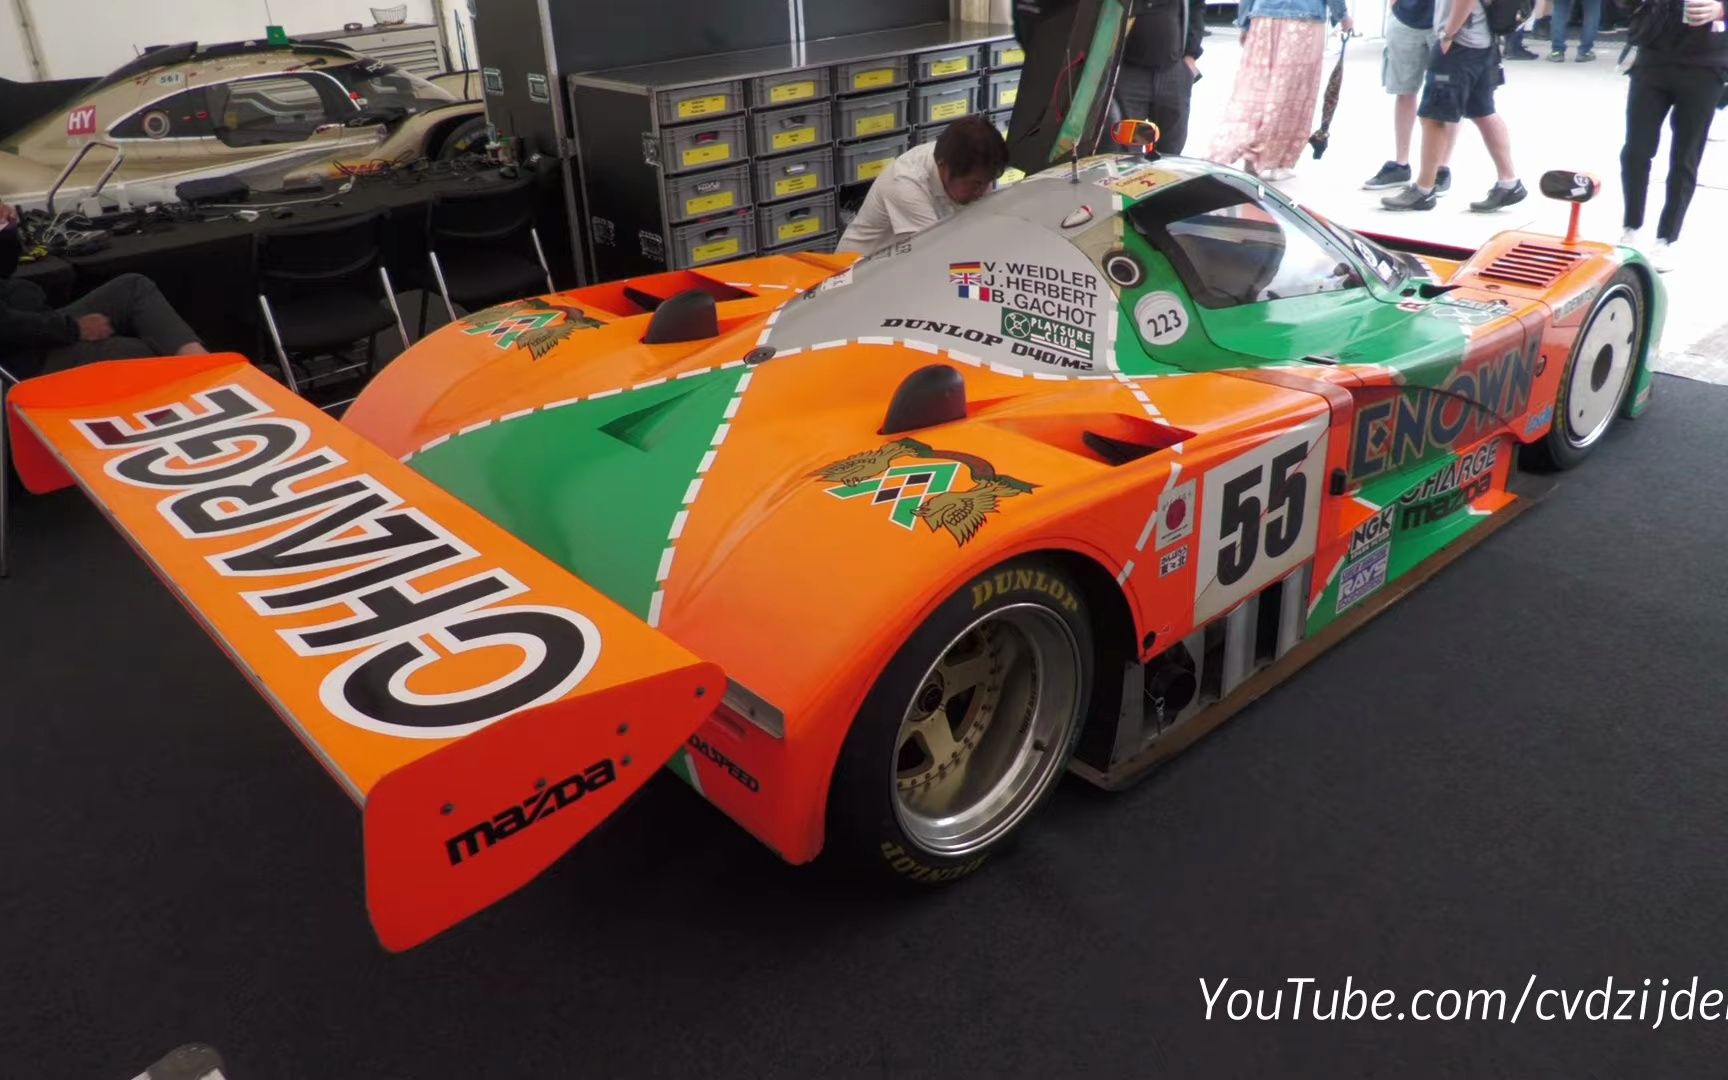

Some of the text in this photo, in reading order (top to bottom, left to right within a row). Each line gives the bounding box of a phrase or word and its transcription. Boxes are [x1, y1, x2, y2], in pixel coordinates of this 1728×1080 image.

[68, 109, 96, 131] HY
[1006, 262, 1097, 291] WEIDLER
[1006, 275, 1098, 309] HERBERT
[1014, 293, 1097, 328] GACHOT
[1147, 309, 1182, 338] 223
[880, 317, 1094, 371] DUNLOP D40/M2
[1030, 316, 1092, 344] PLAYSURE
[1044, 332, 1077, 350] CLUB
[1399, 437, 1503, 505] CHARGE
[1215, 440, 1309, 586] 55
[1351, 507, 1394, 550] NGK
[73, 384, 602, 739] CHARGE
[1341, 558, 1387, 596] RAYS
[971, 568, 1078, 611] DUNLOP
